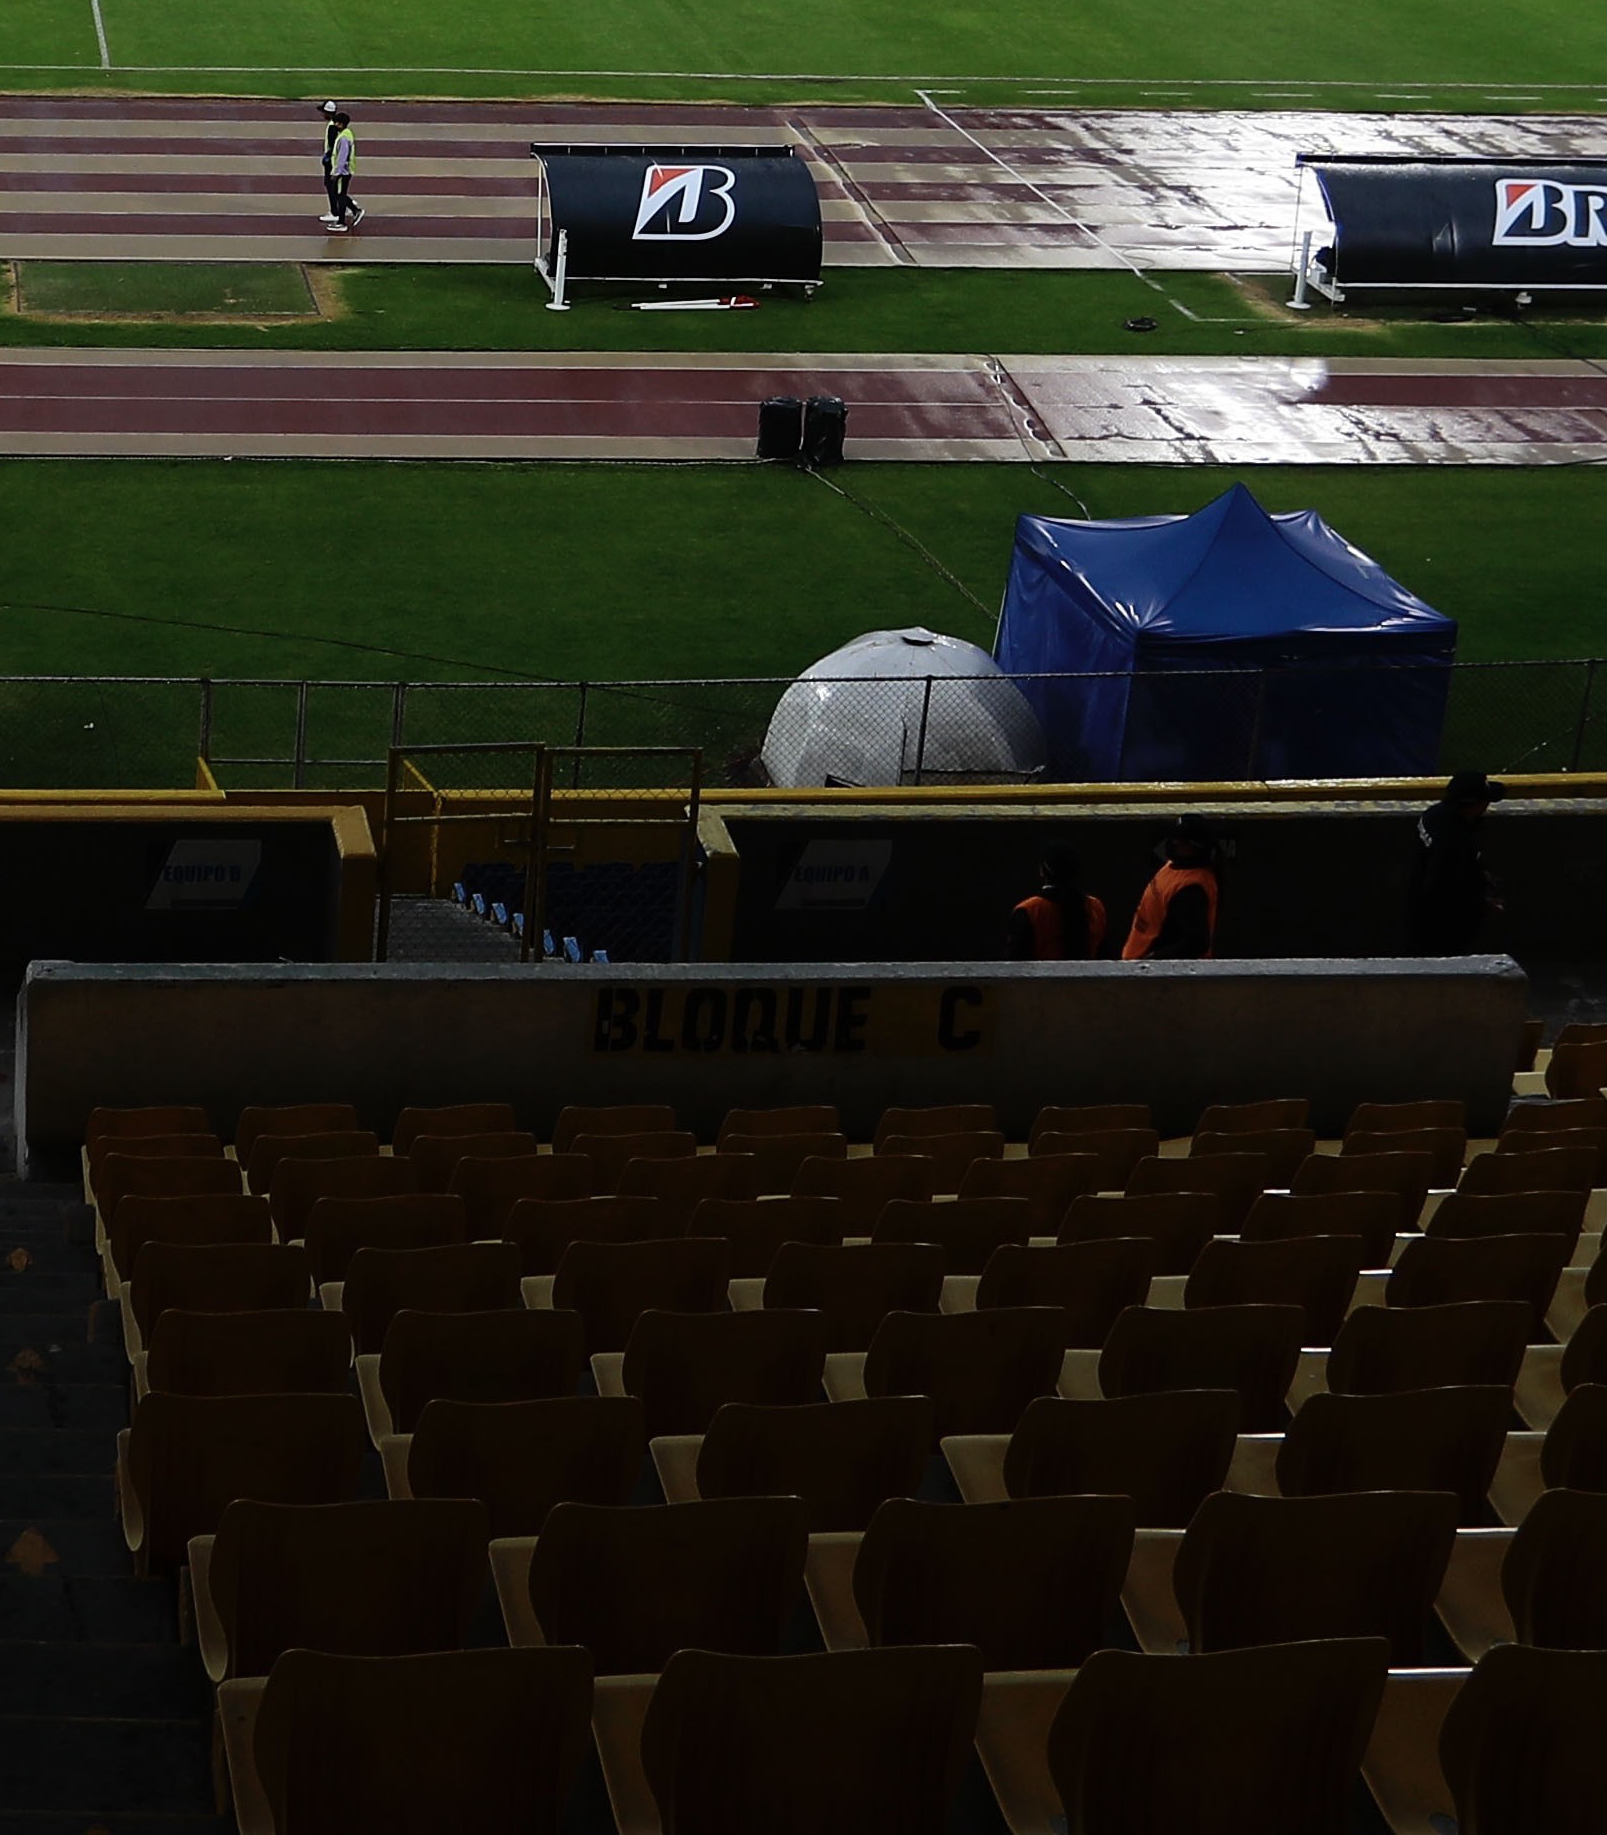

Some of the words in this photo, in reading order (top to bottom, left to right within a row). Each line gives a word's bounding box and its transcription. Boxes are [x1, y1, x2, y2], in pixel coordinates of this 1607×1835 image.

[163, 865, 225, 883] EQUIPO
[794, 864, 855, 884] EQUIPO
[594, 986, 871, 1052] BLOQUE
[938, 986, 983, 1051] C
